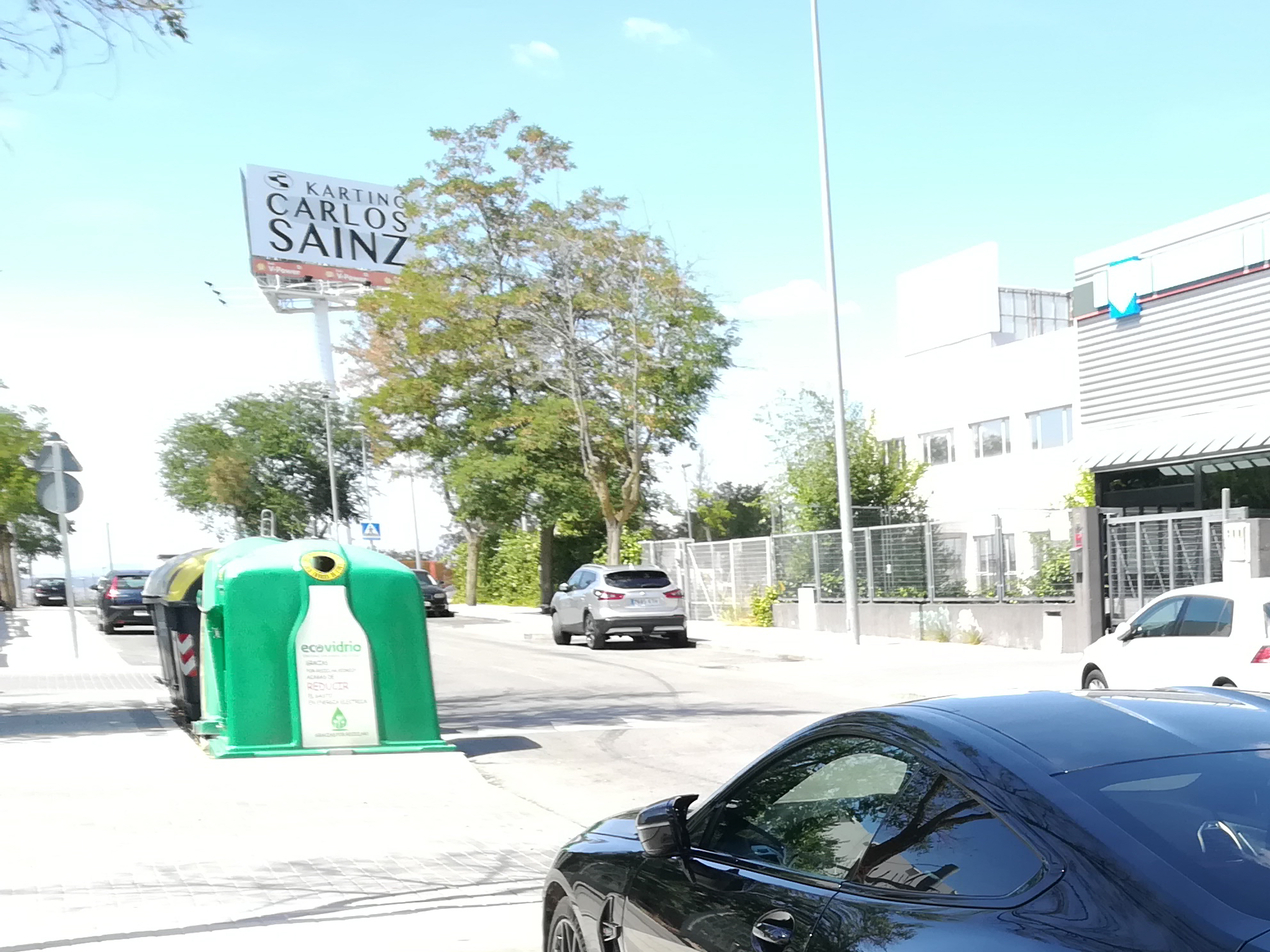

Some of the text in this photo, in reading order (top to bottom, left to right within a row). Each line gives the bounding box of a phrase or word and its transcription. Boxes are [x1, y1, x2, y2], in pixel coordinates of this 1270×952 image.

[266, 193, 407, 232] CARLOS
[269, 219, 408, 267] SAINZ
[301, 641, 362, 653] ecovidrio
[307, 682, 349, 691] REDUCIR
